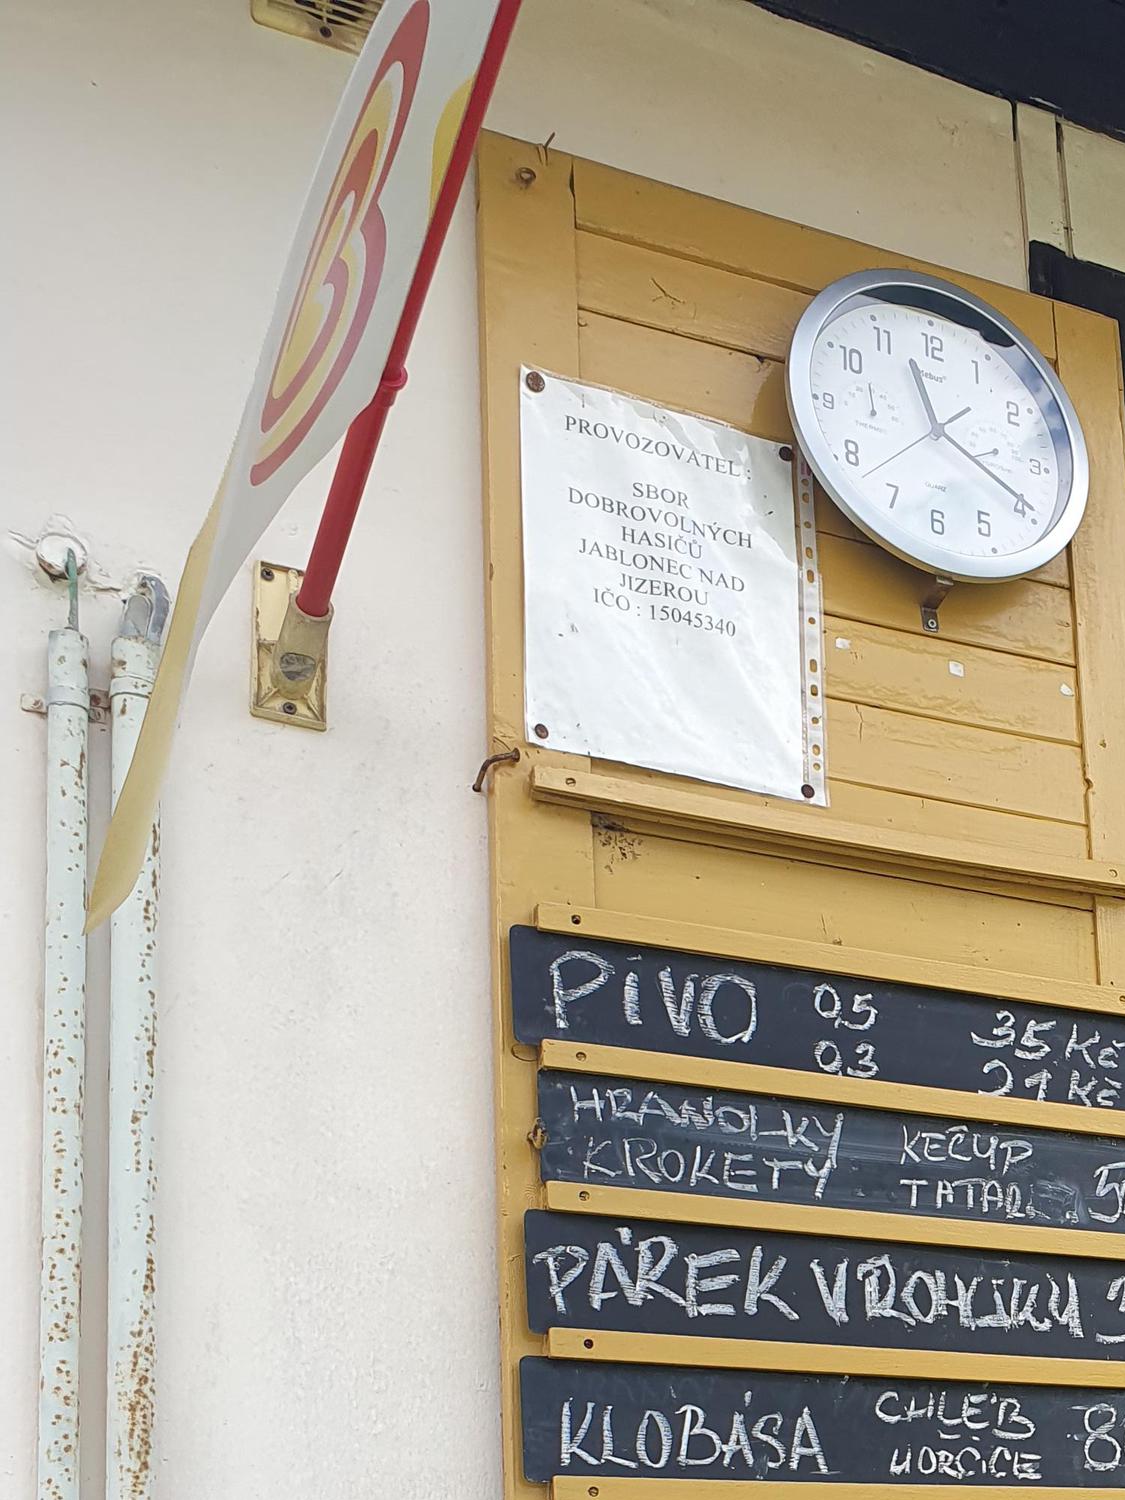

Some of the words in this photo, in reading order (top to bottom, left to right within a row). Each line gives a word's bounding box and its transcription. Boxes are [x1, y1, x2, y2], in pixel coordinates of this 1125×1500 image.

[873, 326, 892, 355] 11
[921, 332, 945, 362] 12
[839, 345, 863, 375] 10
[971, 360, 980, 385] 1
[822, 392, 835, 410] 9
[1006, 401, 1020, 427] 2
[565, 415, 741, 477] PROVOZOVATEL
[844, 439, 860, 467] 8
[1029, 458, 1042, 476] 3
[632, 482, 689, 509] SBOR
[885, 482, 899, 509] 7
[568, 486, 753, 549] DOBROVOLNÝCH
[930, 509, 945, 536] 6
[977, 510, 992, 538] 5
[621, 525, 702, 559] HASIČŮ
[578, 538, 692, 580] JABLONEC
[698, 567, 745, 592] NAD
[619, 573, 709, 606] JIZEROU
[592, 586, 631, 612] IČO
[649, 604, 737, 637] 15045340
[970, 1009, 1057, 1061] 35
[899, 1124, 1035, 1176] KEČUP
[583, 1135, 843, 1200] KROKETY
[532, 1226, 800, 1320] PÁREK
[810, 1256, 850, 1328] V
[559, 1389, 832, 1474] KLOBÁSA
